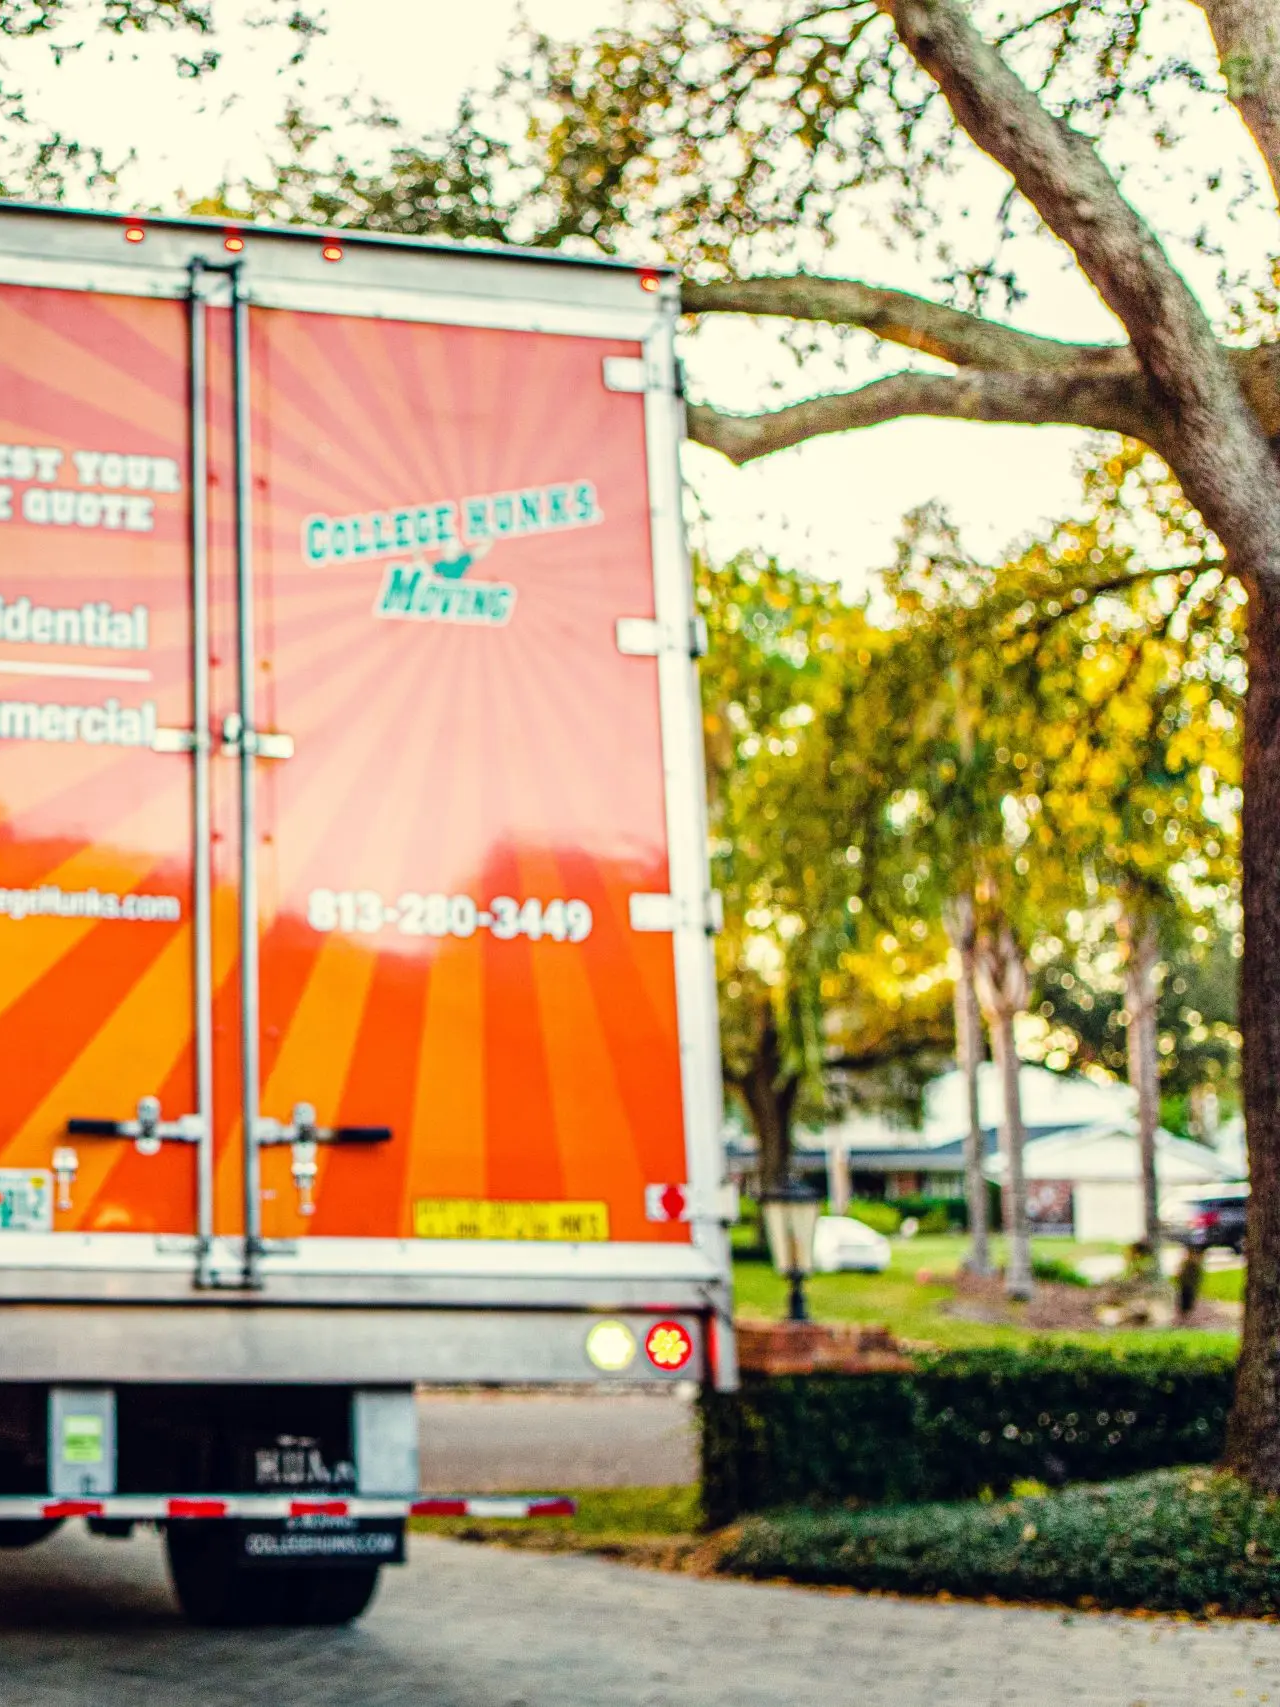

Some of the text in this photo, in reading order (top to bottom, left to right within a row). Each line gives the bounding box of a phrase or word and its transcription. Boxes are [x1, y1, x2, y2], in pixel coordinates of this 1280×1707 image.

[72, 450, 181, 493] YOUR
[23, 488, 154, 531] QUOTE
[301, 501, 457, 568] COLLEGE
[307, 888, 592, 943] 813-280-3449
